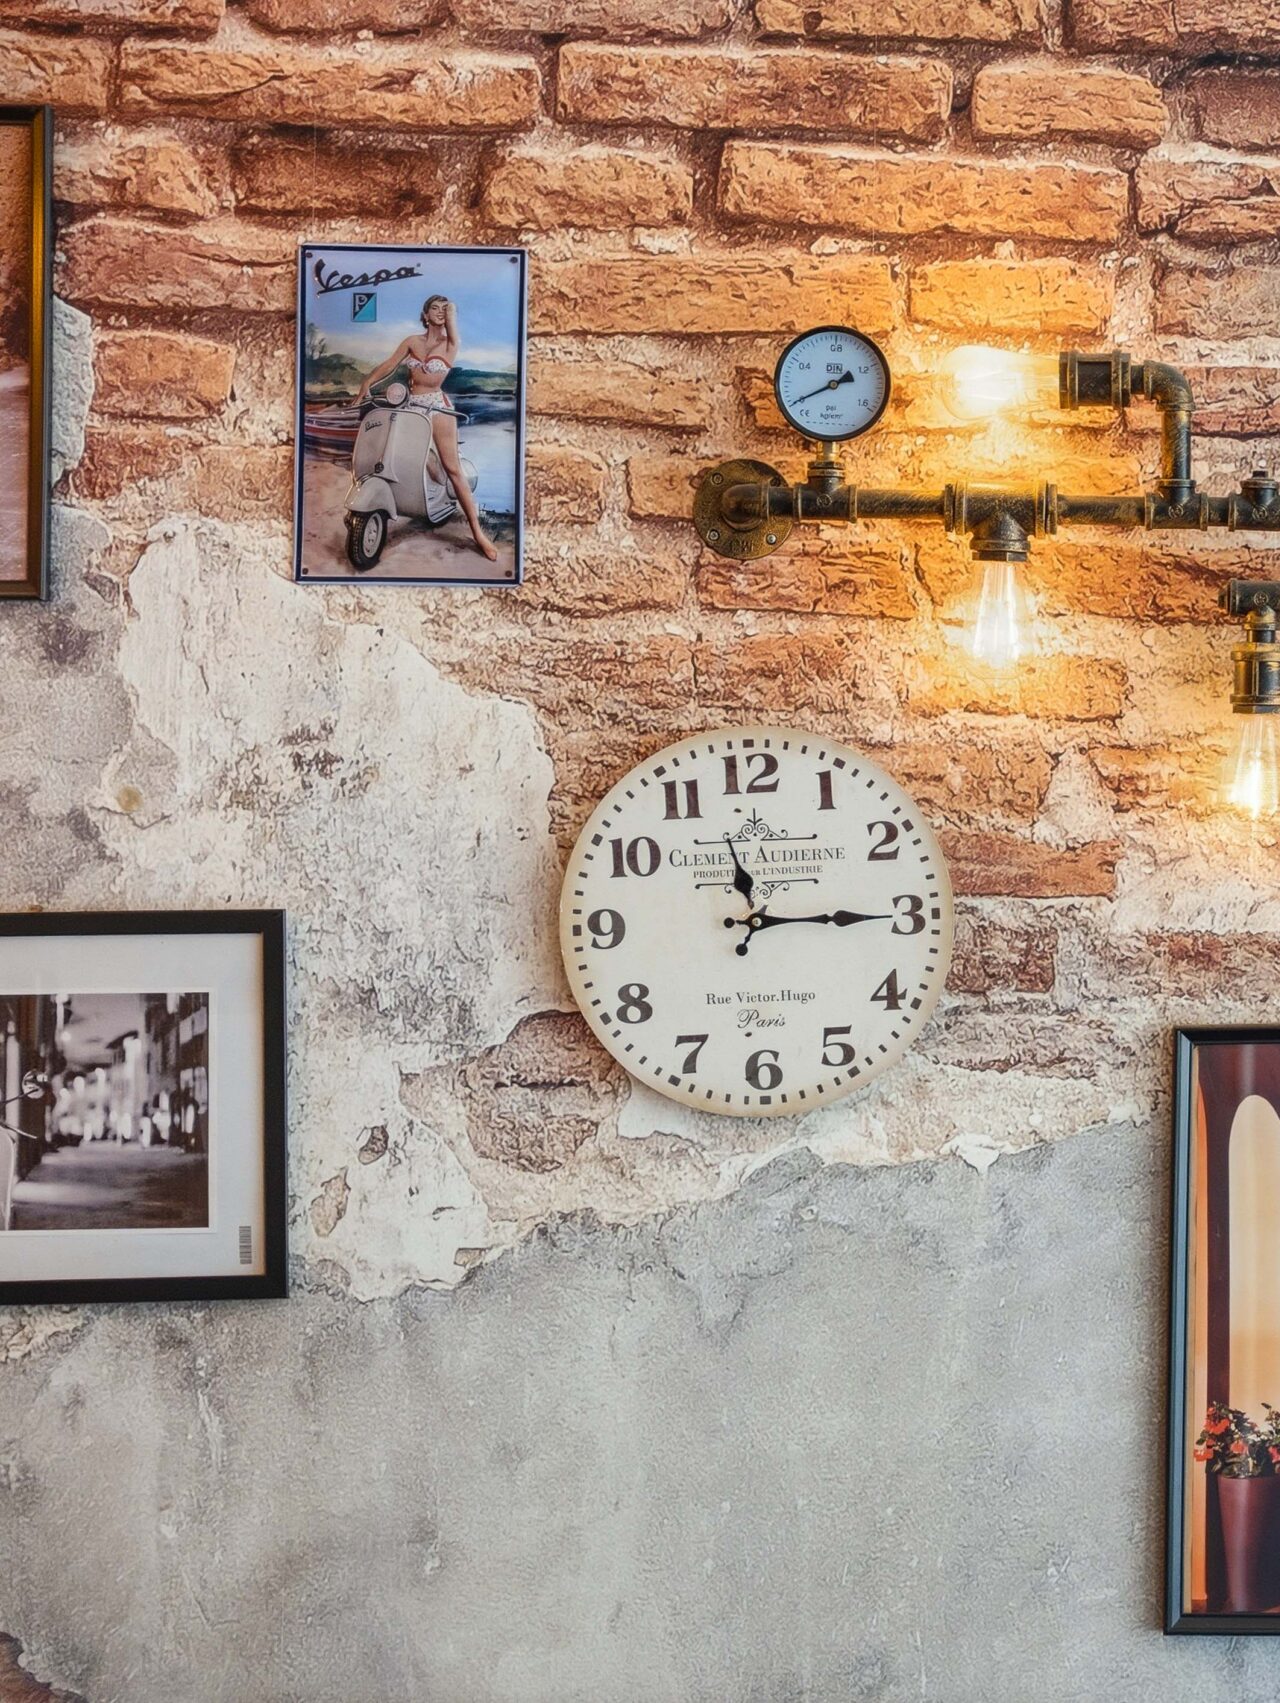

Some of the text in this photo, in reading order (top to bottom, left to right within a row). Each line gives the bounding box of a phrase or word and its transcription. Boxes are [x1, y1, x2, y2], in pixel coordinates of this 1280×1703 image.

[315, 258, 424, 295] Vespa
[826, 364, 843, 372] DIN
[722, 754, 779, 795] 12
[816, 771, 836, 810] 1
[661, 779, 702, 820] 11
[609, 837, 661, 878] 10
[754, 846, 846, 864] AUDIERNE
[867, 821, 899, 861] 2
[588, 909, 625, 949] 9
[892, 895, 925, 935] 3
[617, 984, 652, 1023] 8
[706, 993, 732, 1005] Rue
[870, 968, 907, 1011] 4
[737, 1009, 786, 1029] Paris
[675, 1034, 708, 1074] 7
[821, 1025, 857, 1066] 5
[746, 1050, 782, 1090] 6
